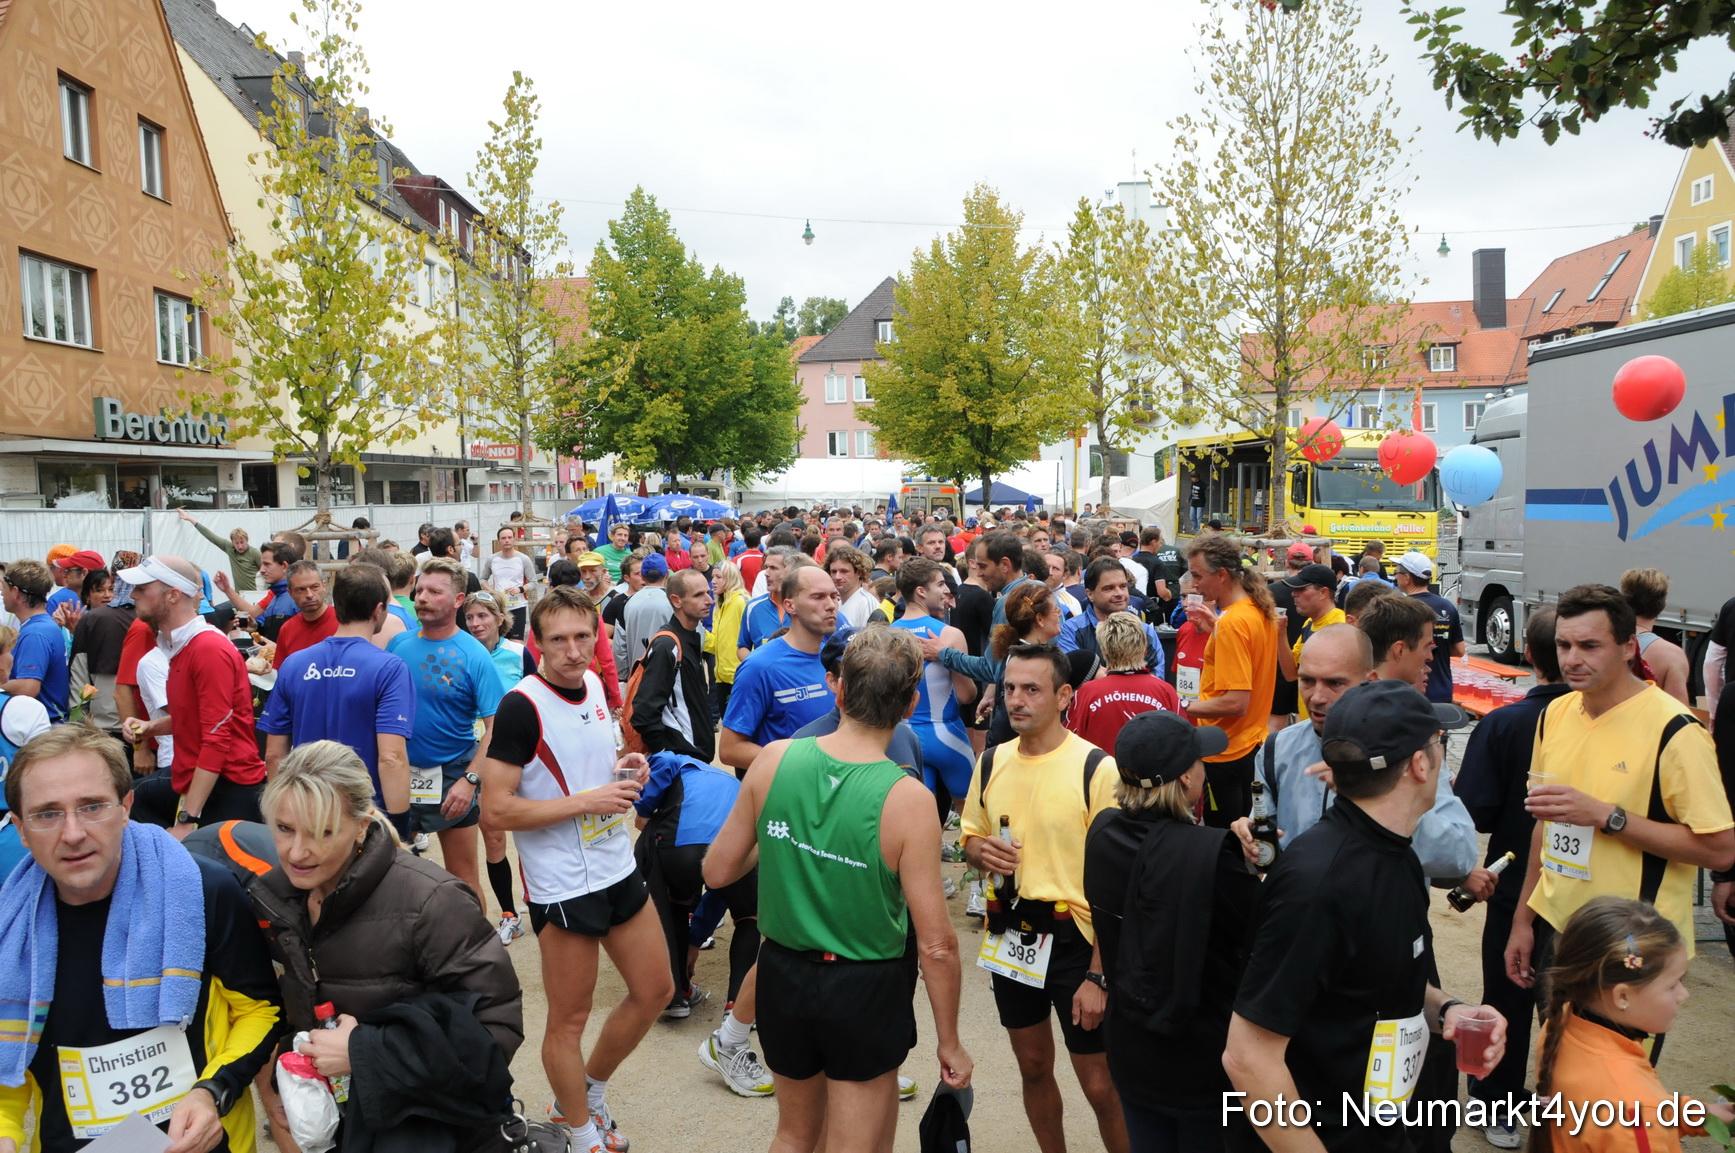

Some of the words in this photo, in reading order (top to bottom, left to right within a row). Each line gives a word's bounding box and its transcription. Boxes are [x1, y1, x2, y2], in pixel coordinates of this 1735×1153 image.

[488, 446, 516, 458] NKD
[1330, 522, 1391, 534] Getränkeland
[1393, 523, 1426, 535] Müller
[1089, 698, 1103, 713] SV
[1553, 833, 1581, 856] 333
[820, 850, 837, 861] Team
[837, 855, 844, 863] in
[844, 857, 868, 869] Bayern
[1007, 941, 1037, 965] 398
[1400, 1027, 1423, 1047] Thomas
[88, 1041, 167, 1074] Christian
[1373, 1058, 1382, 1072] D
[1402, 1050, 1422, 1084] 337
[67, 1085, 76, 1098] C
[108, 1065, 174, 1106] 382
